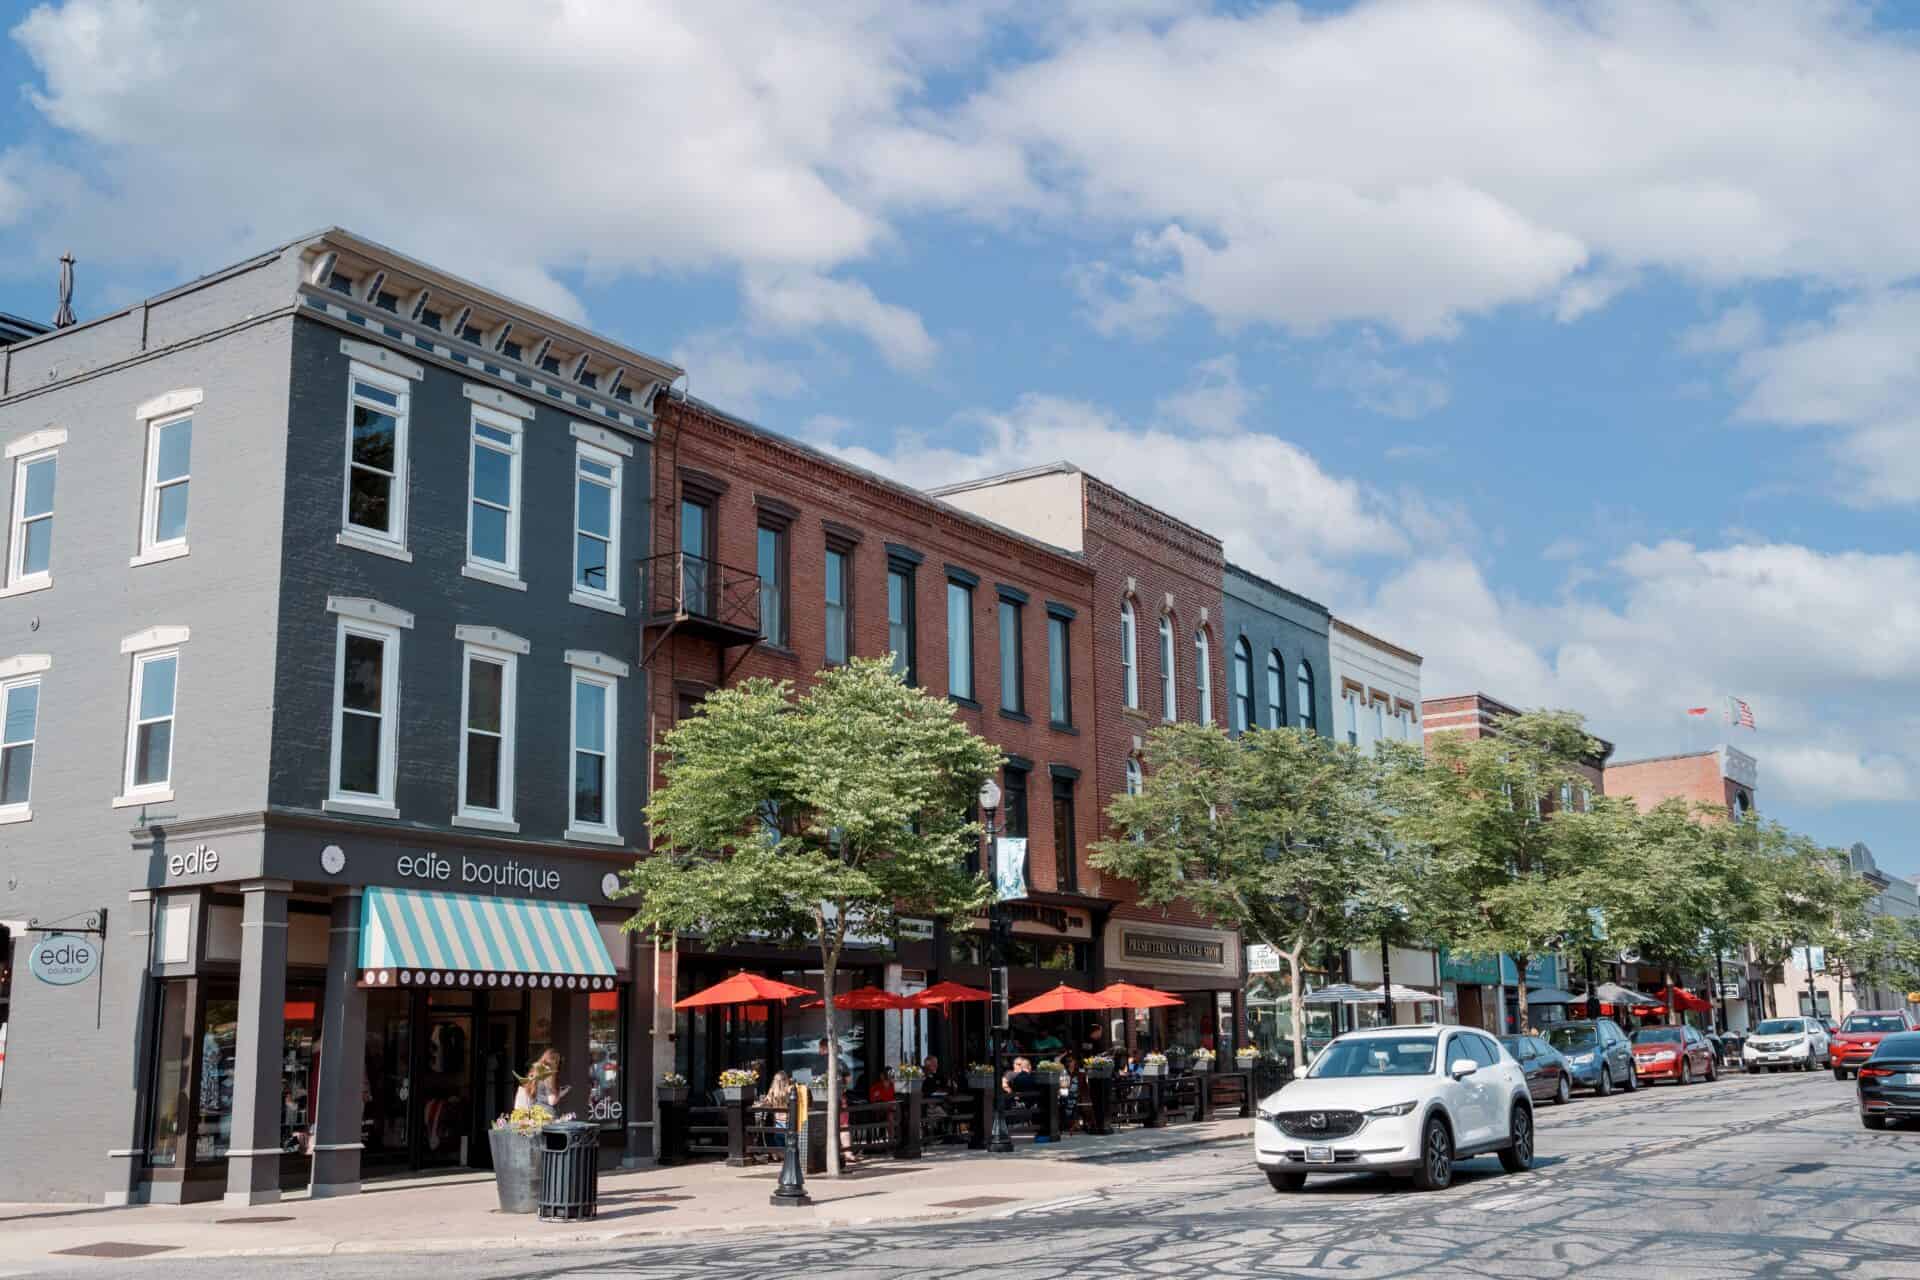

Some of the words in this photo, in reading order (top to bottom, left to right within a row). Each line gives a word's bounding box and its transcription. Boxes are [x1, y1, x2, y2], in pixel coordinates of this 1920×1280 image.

[170, 845, 219, 876] edie
[397, 852, 450, 880] edie
[462, 855, 561, 894] boutique
[40, 944, 89, 965] edie
